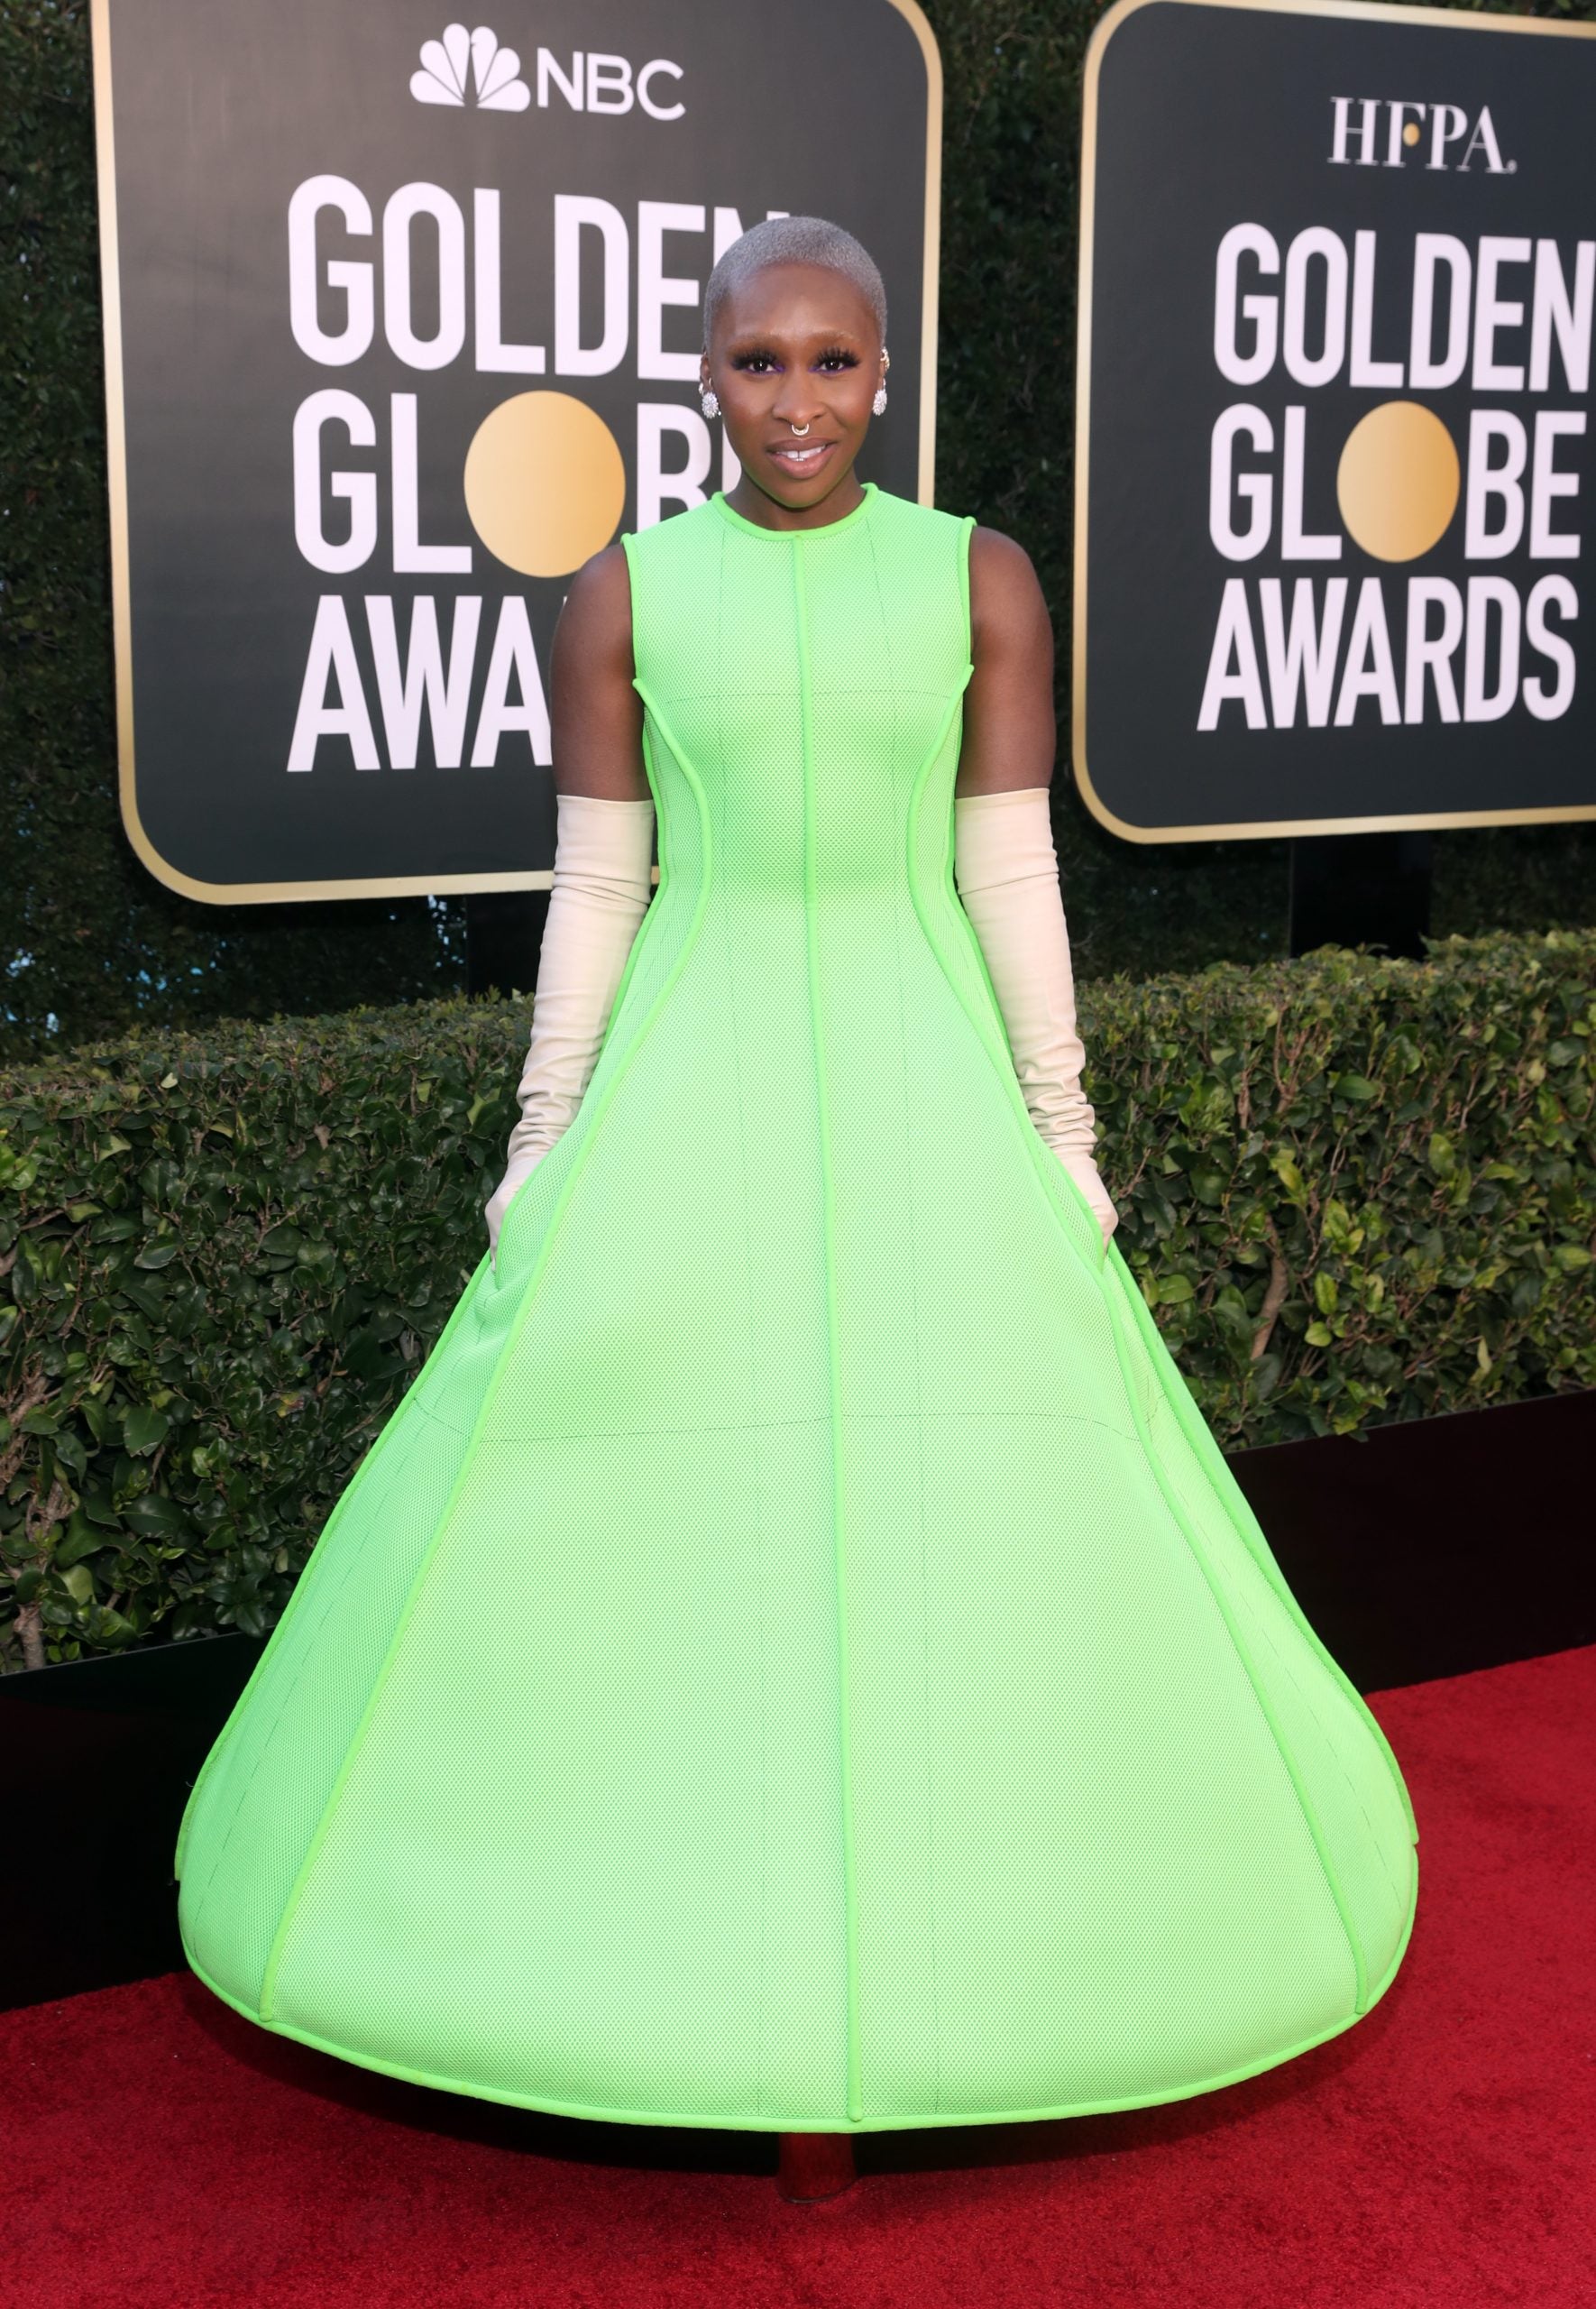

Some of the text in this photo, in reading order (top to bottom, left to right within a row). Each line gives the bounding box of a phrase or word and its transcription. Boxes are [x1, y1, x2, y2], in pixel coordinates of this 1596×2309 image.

[537, 47, 686, 122] NBC
[287, 173, 792, 382] GOLDE
[1213, 221, 1596, 393] GOLDEN
[291, 388, 742, 579] GLOB
[1209, 400, 1587, 563] GLOBE
[287, 593, 568, 773] AWA
[1197, 574, 1580, 732] AWARDS
